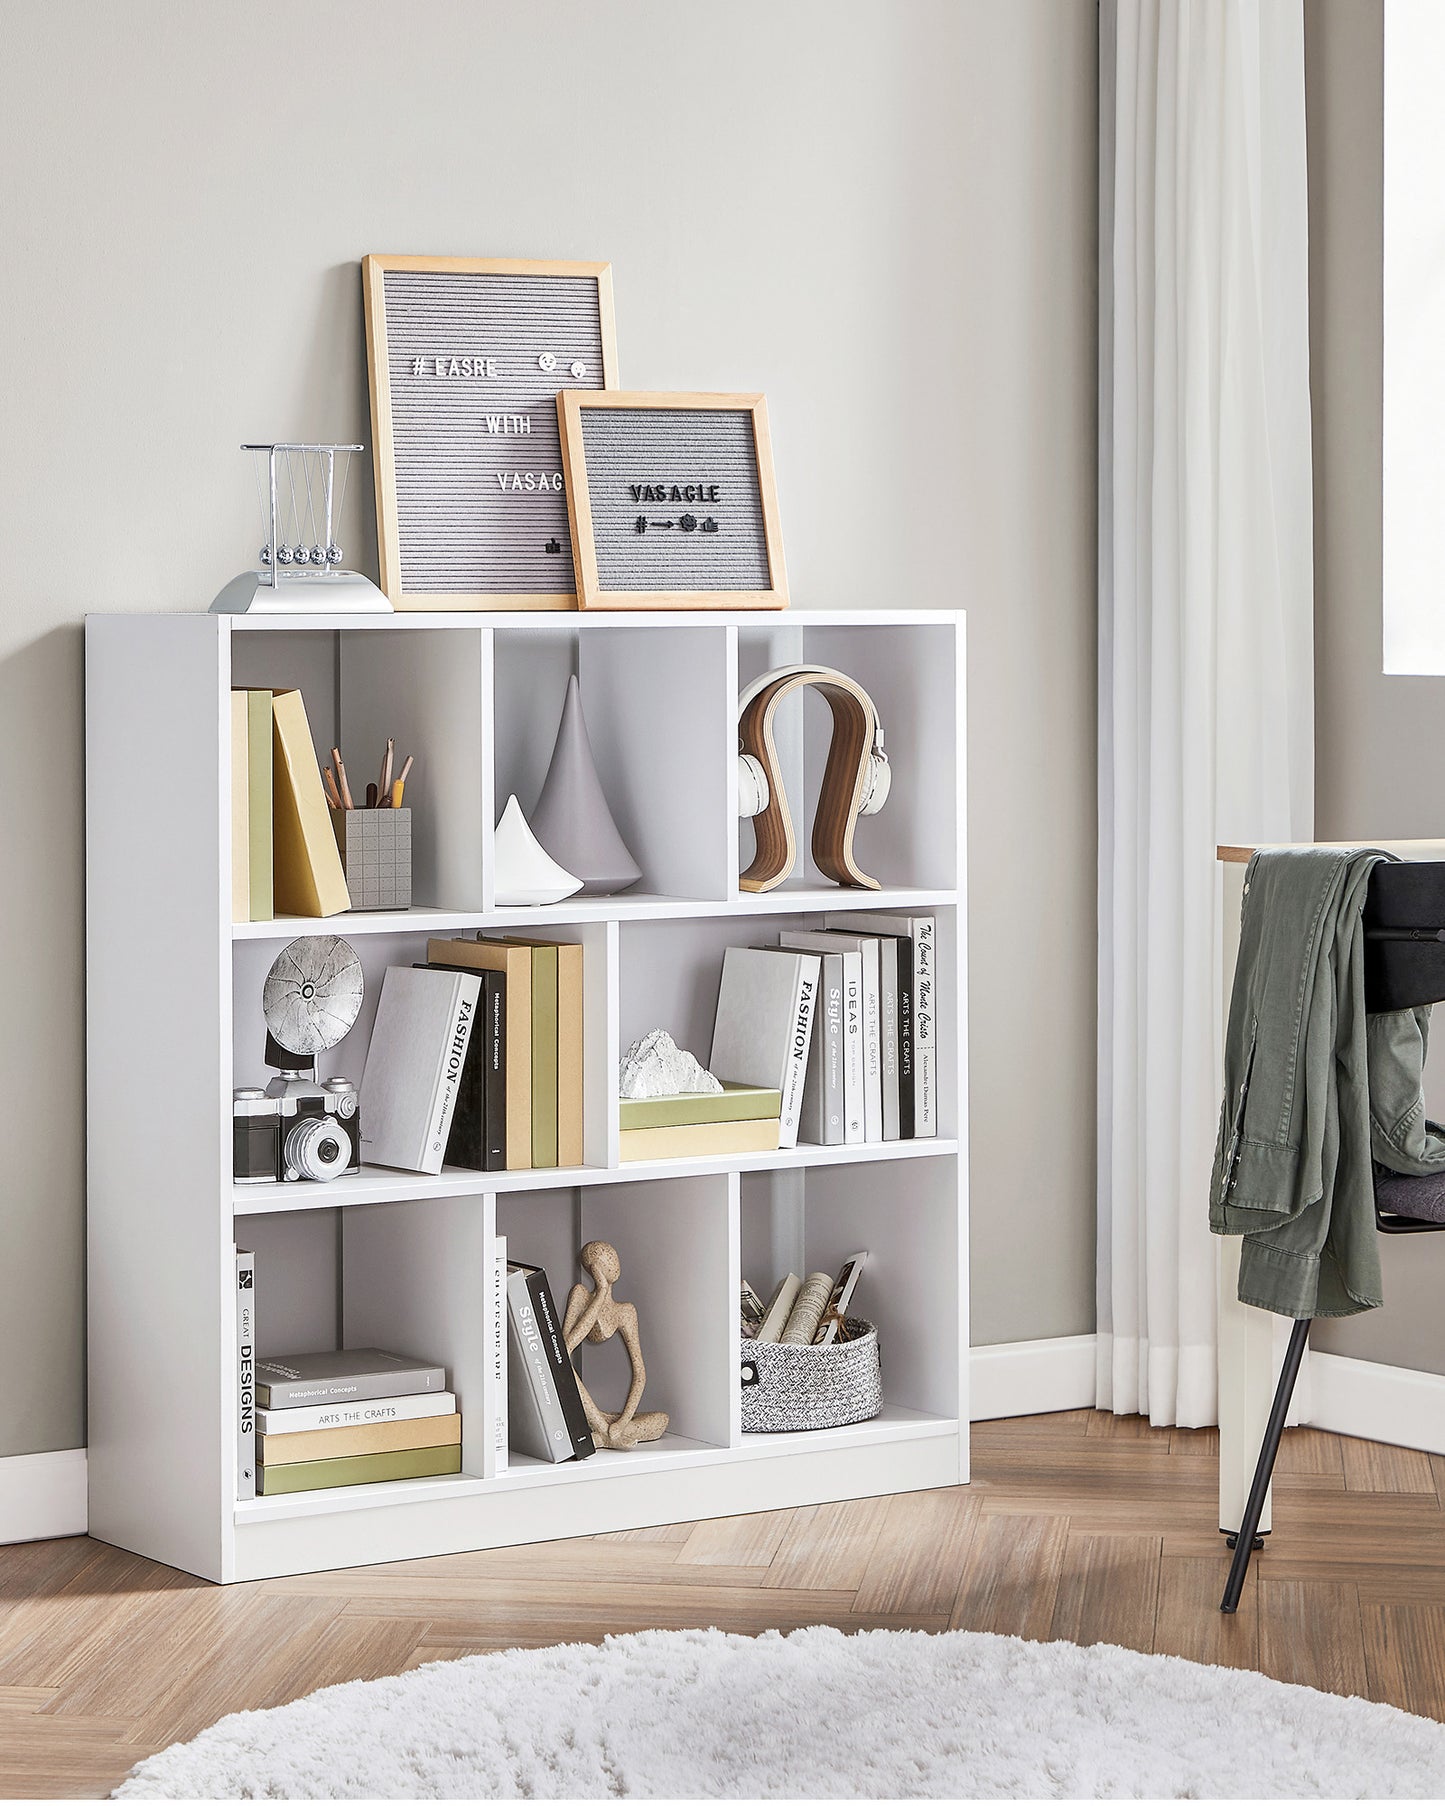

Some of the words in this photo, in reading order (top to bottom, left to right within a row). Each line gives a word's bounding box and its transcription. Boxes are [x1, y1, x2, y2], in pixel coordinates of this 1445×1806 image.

[435, 358, 497, 377] EASRE
[485, 415, 531, 434] WITH
[497, 472, 563, 491] VASAG
[920, 925, 931, 940] The
[918, 942, 932, 966] Count
[916, 967, 930, 976] of
[848, 981, 857, 1034] IDEAS
[902, 992, 910, 1015] ARTS
[920, 981, 931, 1009] Monte
[794, 981, 813, 1060] FASHION
[828, 988, 840, 1034] Style
[917, 1013, 931, 1039] Cristo
[446, 1000, 472, 1083] FASHION
[869, 1042, 877, 1076] CRAFTS
[903, 1041, 911, 1075] CRAFTS
[519, 1306, 539, 1352] Style
[539, 1291, 555, 1333] Metaphorical
[551, 1334, 563, 1364] Concepts
[240, 1345, 252, 1434] DESIGNS
[289, 1388, 328, 1398] Metaphorical
[330, 1386, 357, 1394] Concepts
[319, 1414, 340, 1424] ARTS
[344, 1411, 361, 1421] THE
[364, 1407, 396, 1419] CRAFTS
